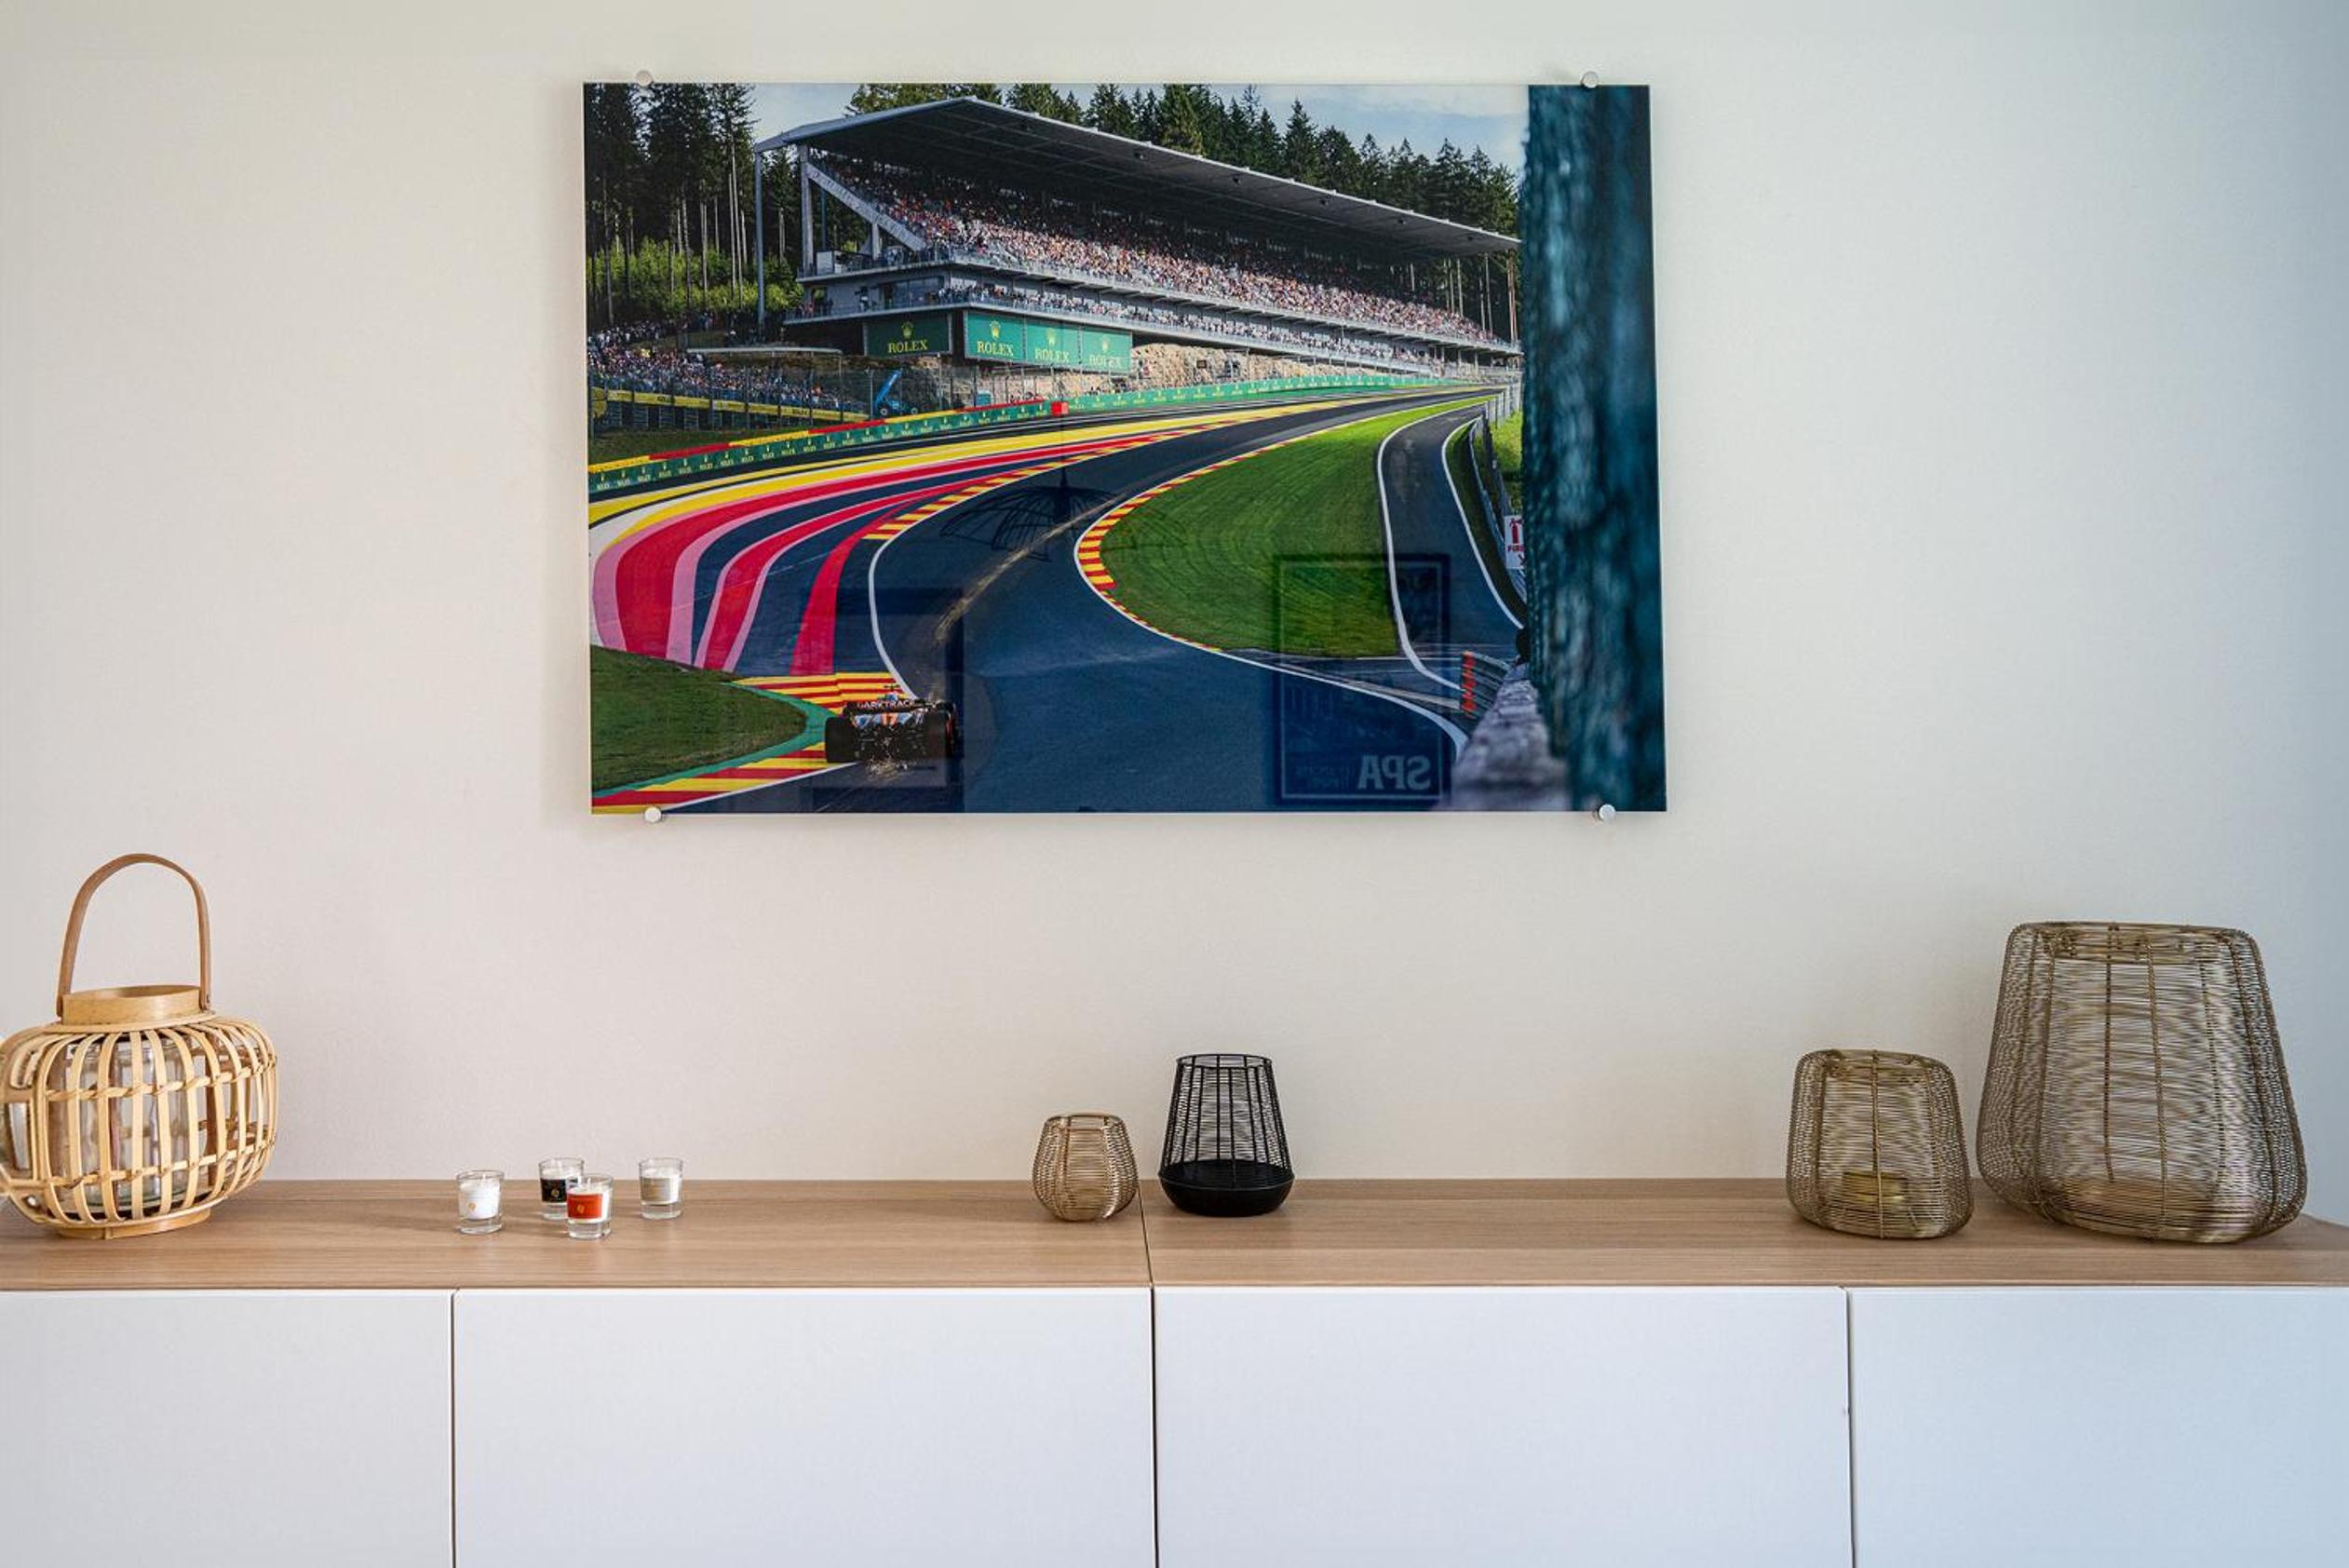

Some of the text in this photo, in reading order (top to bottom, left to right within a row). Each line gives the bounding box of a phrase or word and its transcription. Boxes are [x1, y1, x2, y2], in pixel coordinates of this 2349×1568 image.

[888, 339, 928, 354] ROLEX
[977, 341, 1014, 357] ROLEX
[1034, 347, 1070, 362] ROLEX
